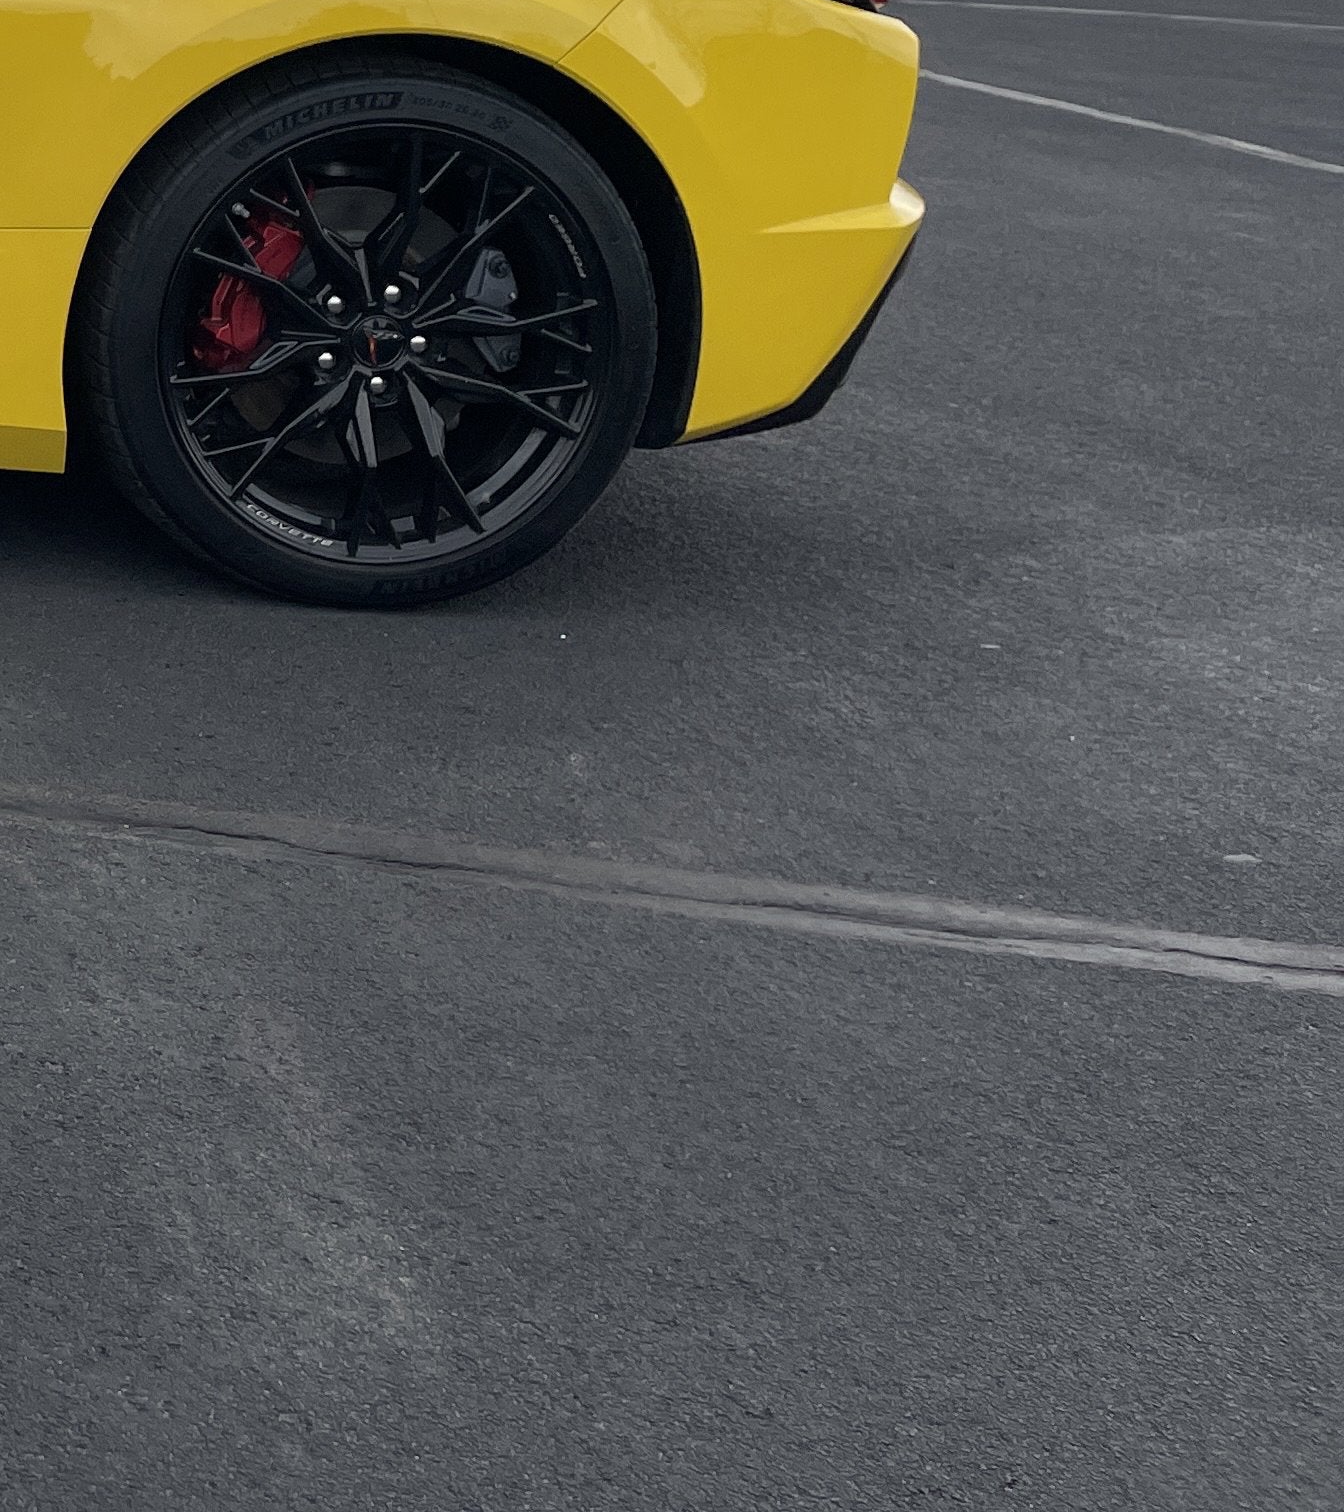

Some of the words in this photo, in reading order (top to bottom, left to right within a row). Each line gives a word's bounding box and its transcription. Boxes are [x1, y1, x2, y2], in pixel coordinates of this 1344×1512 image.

[264, 91, 397, 139] MICHELIN
[548, 213, 587, 279] FORGED
[246, 503, 335, 547] CORVETTE
